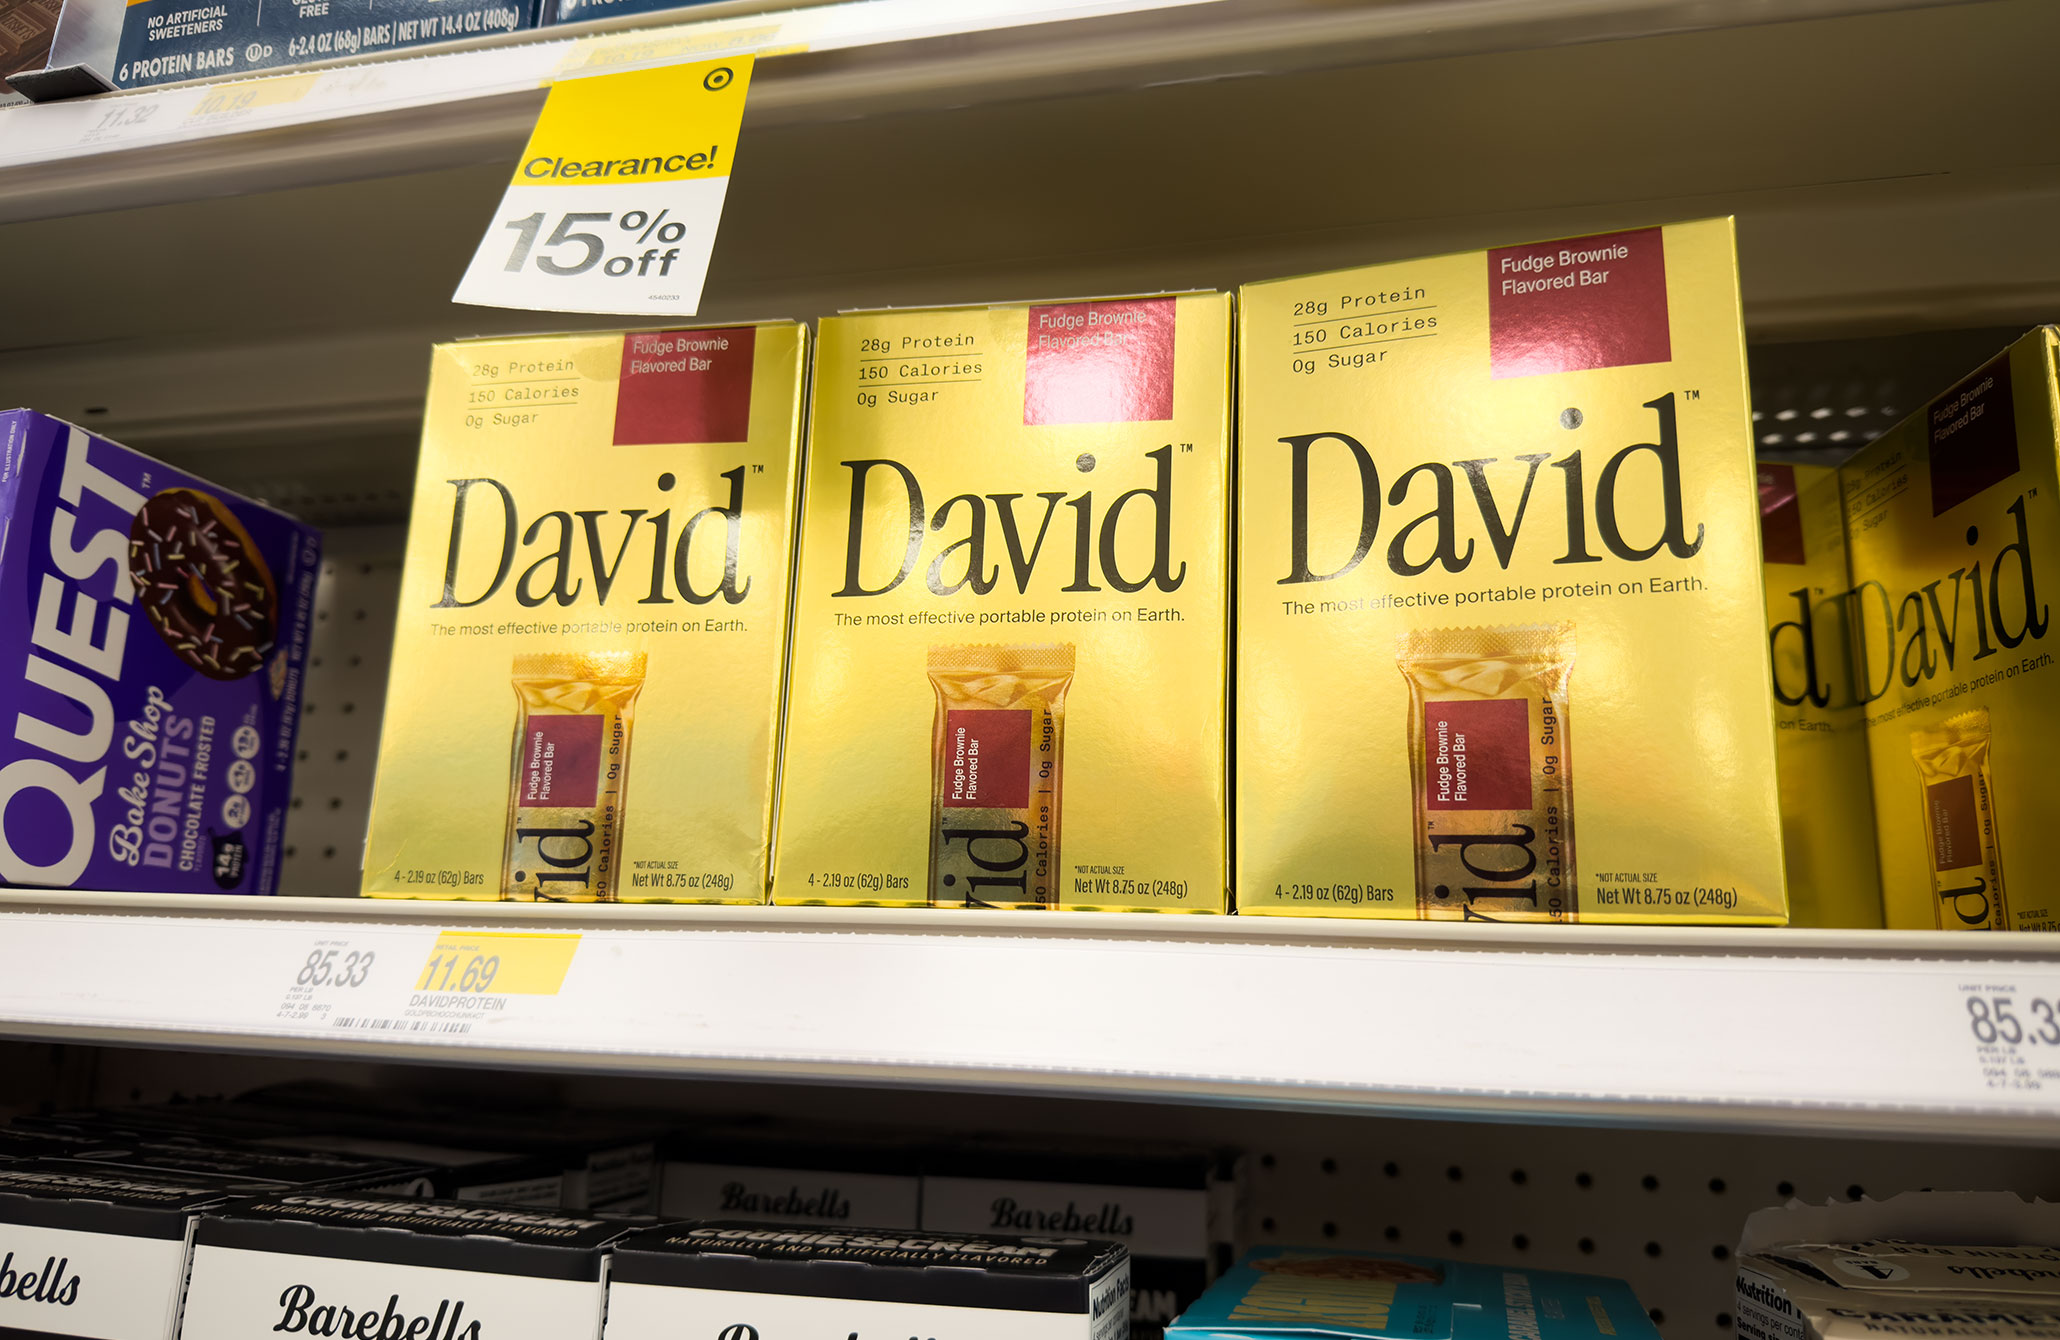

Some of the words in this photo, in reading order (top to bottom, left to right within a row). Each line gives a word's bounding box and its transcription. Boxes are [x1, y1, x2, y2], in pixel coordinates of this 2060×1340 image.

[148, 16, 164, 28] NO
[166, 5, 228, 25] ARTIFICIAL
[299, 2, 330, 18] FREE
[148, 19, 223, 42] SWEETENERS
[288, 34, 315, 57] 6-2.4
[317, 32, 333, 53] OZ
[334, 27, 361, 54] (68g)
[363, 24, 391, 46] BARS
[399, 19, 418, 42] NET
[420, 17, 440, 38] WT
[441, 14, 463, 36] 14.4
[465, 13, 481, 33] OZ
[483, 6, 520, 34] (408g)
[119, 63, 129, 82] 6
[132, 53, 192, 81] PROTEIN
[196, 47, 235, 70] BARS
[97, 104, 159, 129] 11.32
[524, 146, 718, 178] Clearance!
[504, 209, 686, 276] 15%
[603, 249, 680, 277] off
[1501, 254, 1555, 275] Fudge
[1558, 244, 1629, 267] Brownie
[1501, 273, 1576, 297] Flavored
[1579, 269, 1609, 288] Bar
[1293, 300, 1328, 317] 28g
[1340, 287, 1426, 310] Protein
[1039, 312, 1084, 330] Fudge
[1088, 309, 1147, 326] Brownie
[1293, 329, 1327, 346] 150
[1339, 316, 1438, 341] Calories
[633, 339, 673, 356] Fudge
[677, 337, 729, 353] Brownie
[861, 338, 891, 354] 28g
[901, 333, 975, 349] Protein
[1038, 332, 1099, 349] Flavored
[1102, 331, 1128, 346] Bar
[473, 364, 499, 379] 28g
[509, 358, 574, 375] Protein
[631, 359, 685, 375] Flavored
[688, 357, 713, 373] Bar
[858, 366, 889, 380] 150
[899, 362, 982, 379] Calories
[1292, 358, 1316, 375] 0g
[1328, 348, 1388, 370] Sugar
[468, 389, 495, 404] 150
[505, 385, 580, 401] Calories
[857, 391, 877, 408] 0g
[887, 389, 939, 405] Sugar
[1933, 402, 1959, 425] Fudge
[1960, 375, 1994, 404] Brownie
[8, 421, 17, 434] ONLY
[465, 414, 483, 429] 0g
[493, 411, 539, 427] Sugar
[1934, 415, 1968, 444] Flavored
[1970, 403, 1985, 422] Bar
[1276, 391, 1705, 585] David
[831, 444, 1186, 597] David
[429, 465, 752, 609] David
[1282, 599, 1315, 615] The
[1320, 596, 1365, 612] most
[1369, 590, 1449, 611] effective
[1454, 583, 1536, 606] portable
[1542, 579, 1612, 602] protein
[1618, 580, 1644, 593] on
[1650, 575, 1709, 592] Earth.
[1857, 494, 2049, 706] David
[430, 623, 455, 636] The
[460, 623, 494, 635] most
[498, 621, 558, 635] effective
[562, 620, 622, 638] portable
[626, 620, 678, 637] protein
[681, 622, 700, 633] on
[704, 618, 748, 632] Earth.
[834, 612, 862, 626] The
[866, 612, 904, 625] most
[908, 610, 975, 625] effective
[979, 609, 1046, 627] portable
[1050, 609, 1107, 625] protein
[1111, 611, 1133, 622] on
[1136, 607, 1185, 622] Earth.
[0, 425, 149, 887] QUEST
[1896, 696, 1931, 719] effective
[1931, 682, 1968, 706] portable
[1970, 667, 2004, 693] protein
[2006, 665, 2019, 679] on
[2021, 653, 2055, 674] Earth.
[124, 685, 174, 769] Shop
[1040, 709, 1054, 752] Sugar
[1540, 698, 1554, 745] Sugar
[531, 731, 543, 769] Brownie
[544, 741, 556, 758] Bar
[954, 727, 966, 766] Brownie
[969, 738, 980, 755] Bar
[1436, 720, 1448, 765] Brownie
[1453, 733, 1466, 752] Bar
[142, 714, 194, 869] DONUTS
[178, 783, 206, 872] CHOCOLATE
[195, 715, 216, 783] FROSTED
[527, 770, 540, 801] Fudge
[540, 760, 553, 801] Flavored
[952, 768, 964, 801] Fudge
[966, 757, 979, 800] Flavored
[1436, 767, 1450, 802] Fudge
[1454, 754, 1467, 801] Flavored
[109, 771, 150, 867] Bake
[1036, 805, 1049, 878] Calories
[1547, 806, 1560, 887] Calories
[437, 869, 461, 887] (62g)
[463, 872, 483, 885] Bars
[632, 873, 648, 887] Net
[702, 872, 734, 891] (248g)
[857, 873, 884, 891] (62g)
[886, 874, 909, 889] Bars
[1074, 879, 1093, 893] Net
[1095, 879, 1110, 894] Wt
[1112, 880, 1135, 895] 8.75
[1152, 879, 1188, 899] (248g)
[1331, 884, 1363, 903] (62g)
[1366, 885, 1393, 901] Bars
[1597, 888, 1617, 904] Net
[1620, 888, 1641, 905] Wt
[1643, 889, 1672, 905] 8.75
[1693, 888, 1738, 908] (248g)
[296, 948, 376, 988] 85.33
[423, 954, 500, 993] 11.69
[409, 994, 507, 1010] DAVIDPROTEIN
[1966, 996, 2060, 1045] 85.3
[719, 1181, 851, 1219] Barebells
[251, 1203, 337, 1217] NATURALLY
[340, 1210, 380, 1221] AND
[383, 1215, 487, 1230] ARTIFICIALLY
[491, 1224, 579, 1238] FLAVORED
[989, 1197, 1135, 1236] Barebells
[665, 1236, 770, 1252] NATURALLY
[772, 1243, 812, 1254] AND
[817, 1246, 944, 1261] ARTIFICIALLY
[949, 1253, 1048, 1266] FLAVORED
[272, 1283, 483, 1340] Barebells
[1093, 1287, 1116, 1320] Nutrition
[1736, 1275, 1792, 1316] Nutrition
[1742, 1305, 1769, 1327] servings
[1770, 1319, 1782, 1331] per
